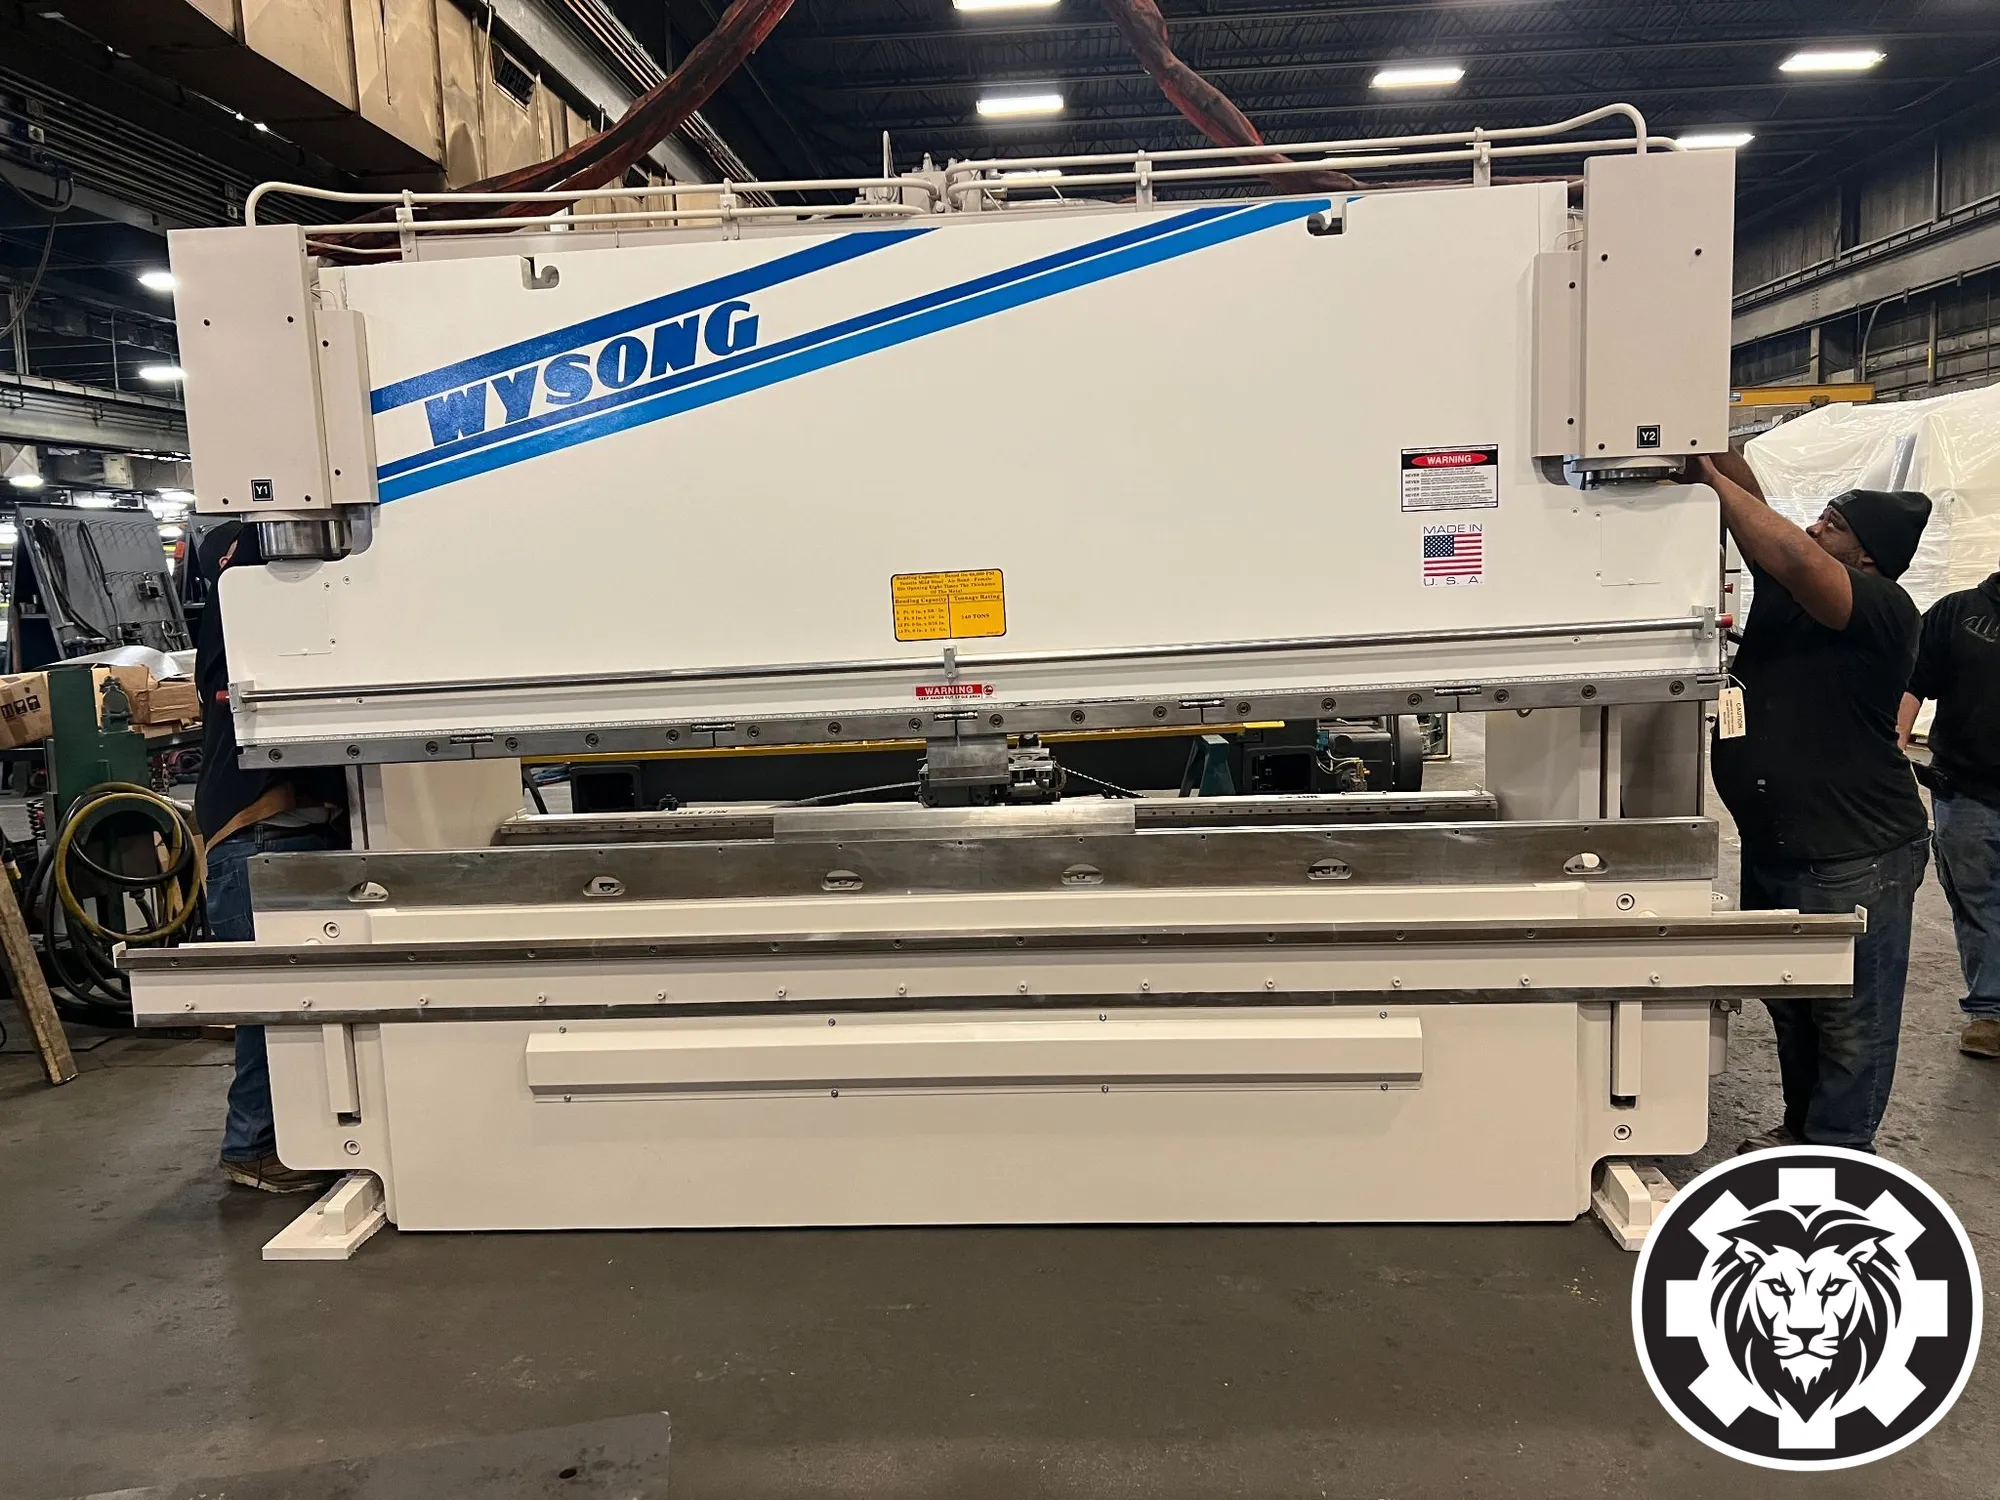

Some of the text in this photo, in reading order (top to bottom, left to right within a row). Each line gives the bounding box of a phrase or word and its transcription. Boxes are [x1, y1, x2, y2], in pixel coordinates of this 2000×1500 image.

[424, 300, 760, 447] WYSONG
[1641, 431, 1656, 441] Y2
[1426, 454, 1472, 465] WARNING
[255, 485, 268, 495] Y1
[1423, 523, 1483, 534] MADE IN
[924, 685, 974, 695] WARNING
